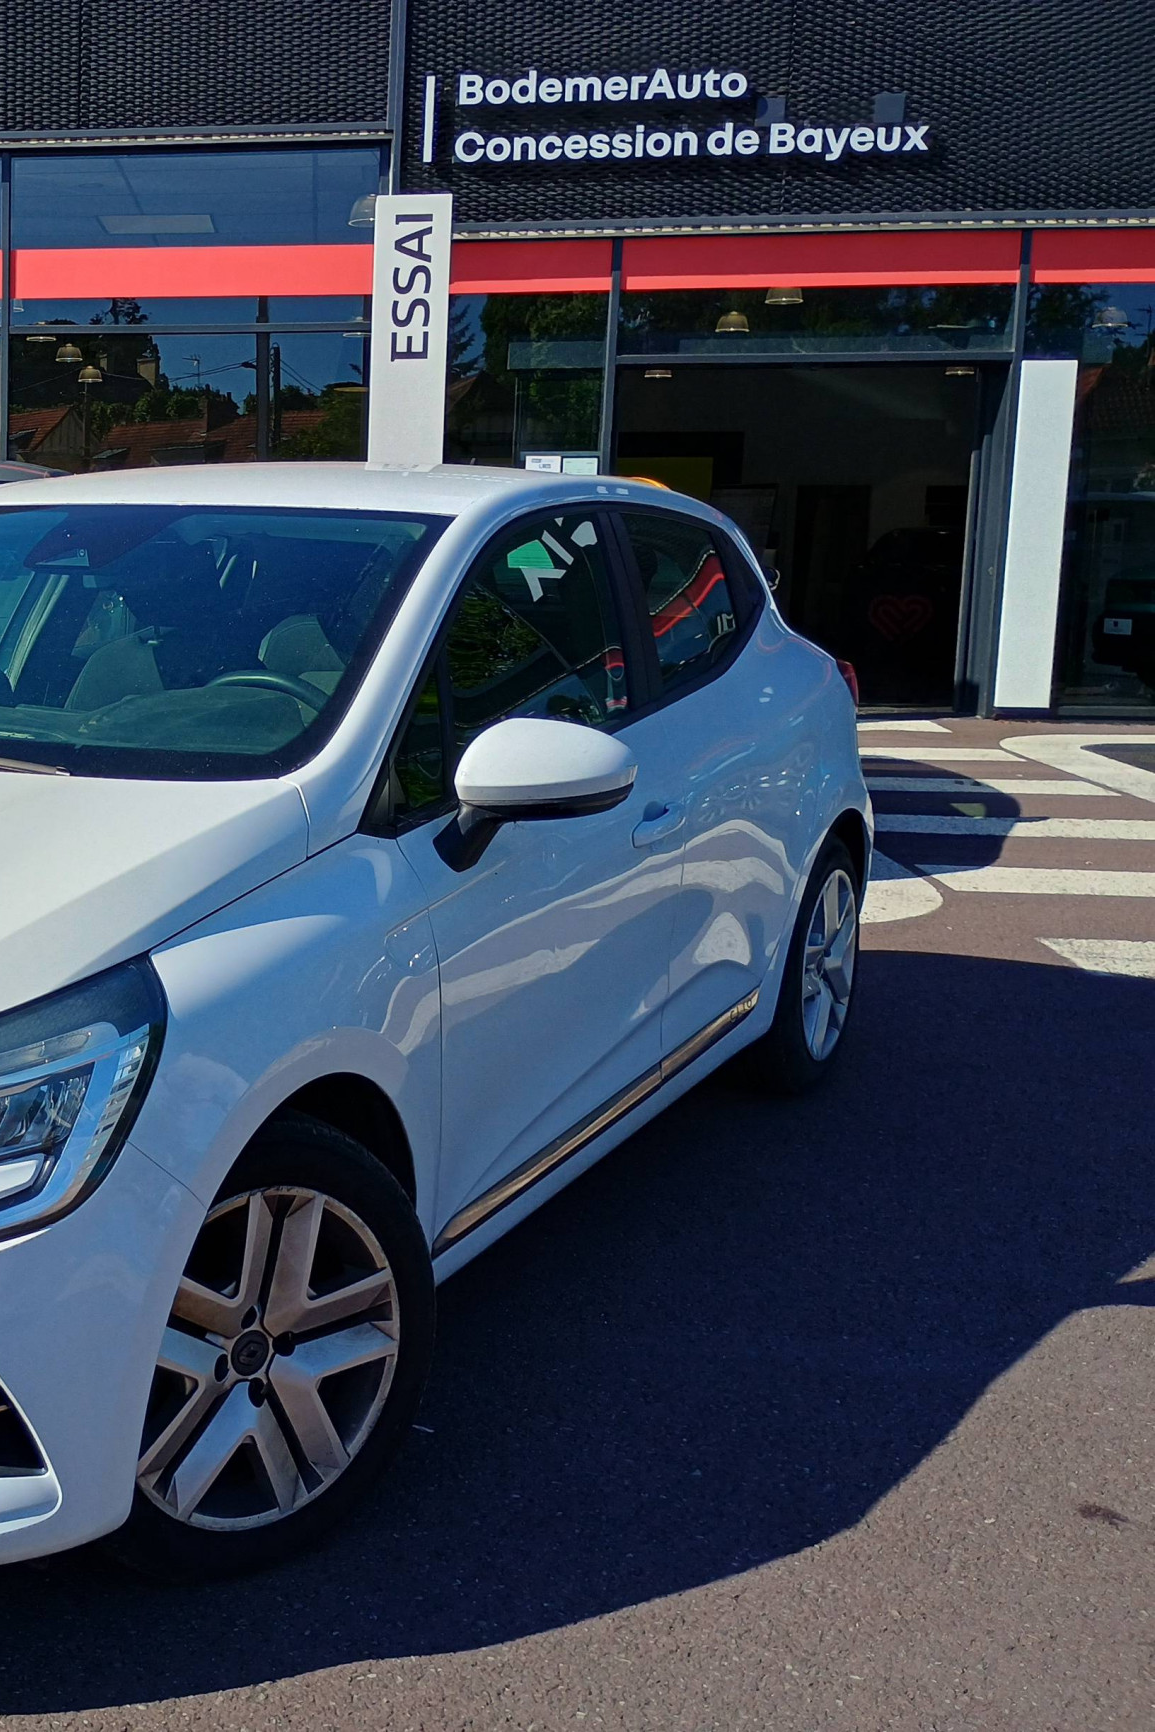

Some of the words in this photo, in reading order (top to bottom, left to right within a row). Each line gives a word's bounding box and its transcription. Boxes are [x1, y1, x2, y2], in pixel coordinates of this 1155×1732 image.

[458, 68, 748, 105] BodemerAuto
[453, 125, 698, 162] Concession
[706, 122, 760, 156] de
[769, 122, 930, 161] Bayeux
[390, 213, 434, 362] ESSAI
